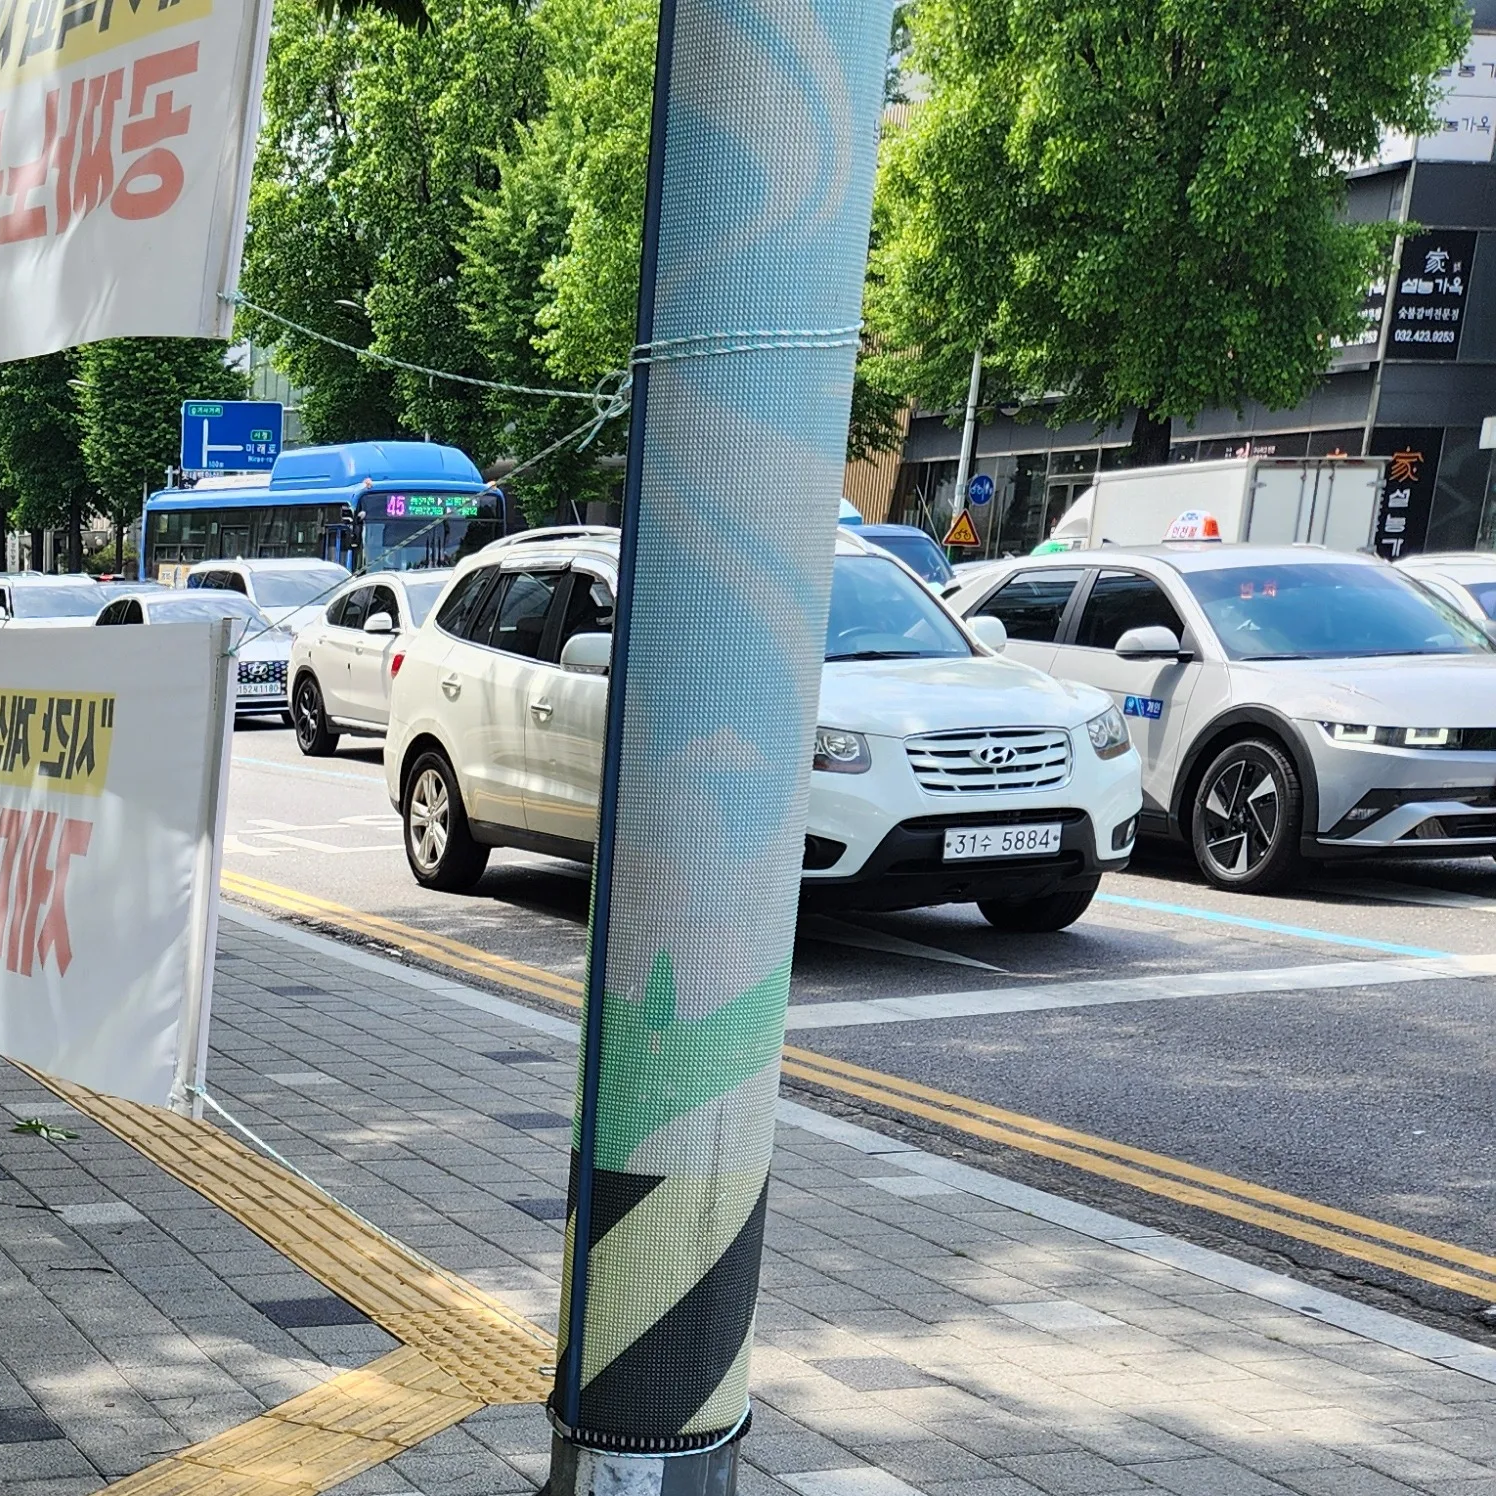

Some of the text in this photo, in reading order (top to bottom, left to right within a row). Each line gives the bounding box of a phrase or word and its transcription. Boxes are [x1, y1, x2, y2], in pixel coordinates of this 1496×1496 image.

[1425, 247, 1450, 274] 家
[245, 443, 277, 455] 미래로
[1389, 445, 1424, 482] 家
[387, 495, 405, 515] 45
[954, 828, 1050, 854] 31수 5884
